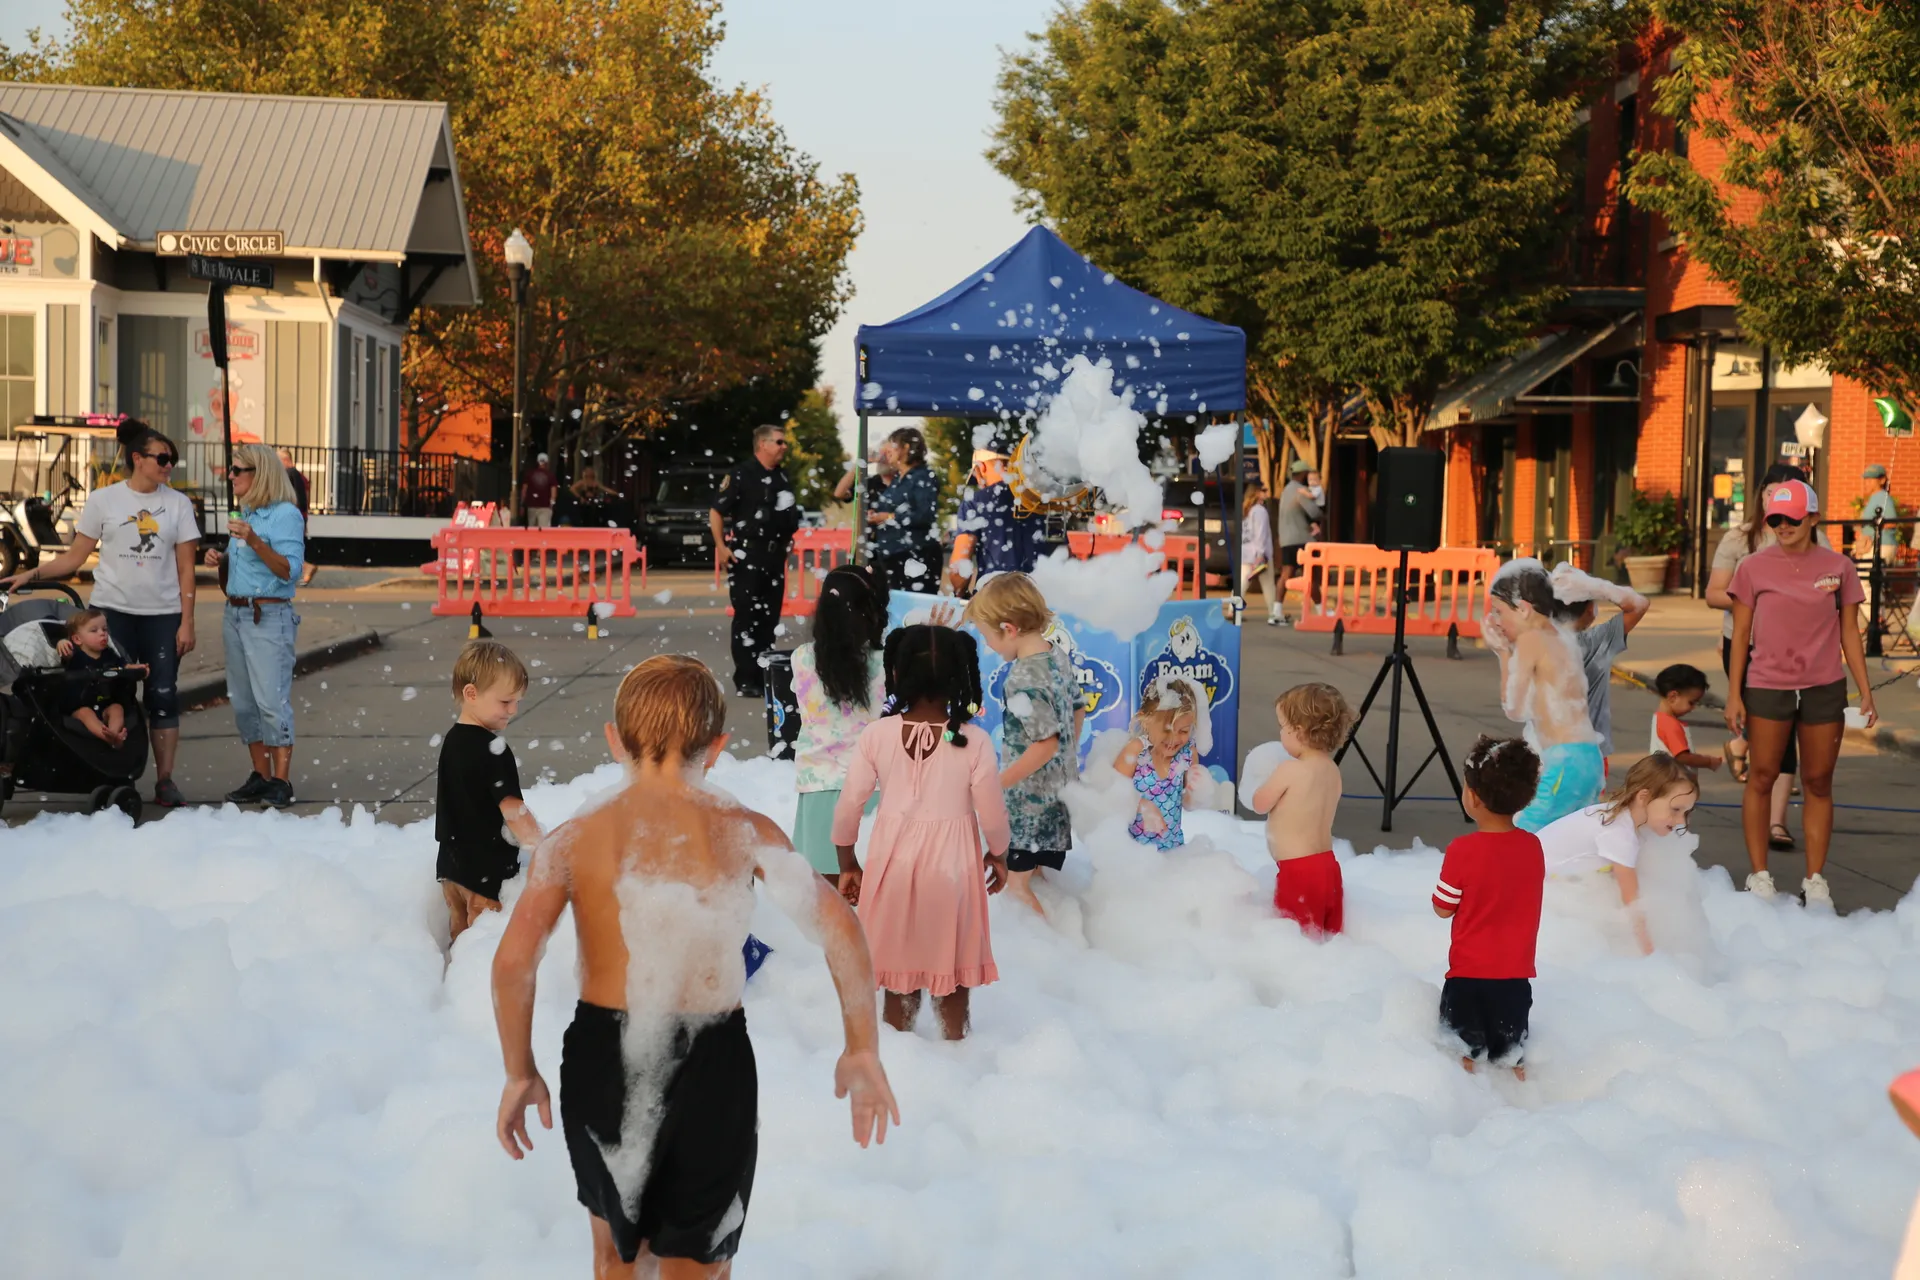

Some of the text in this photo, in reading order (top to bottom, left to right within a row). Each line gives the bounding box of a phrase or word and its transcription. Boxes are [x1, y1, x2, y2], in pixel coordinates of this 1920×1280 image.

[179, 234, 276, 252] CIVIC CIRCLE
[1158, 661, 1213, 680] Foam
